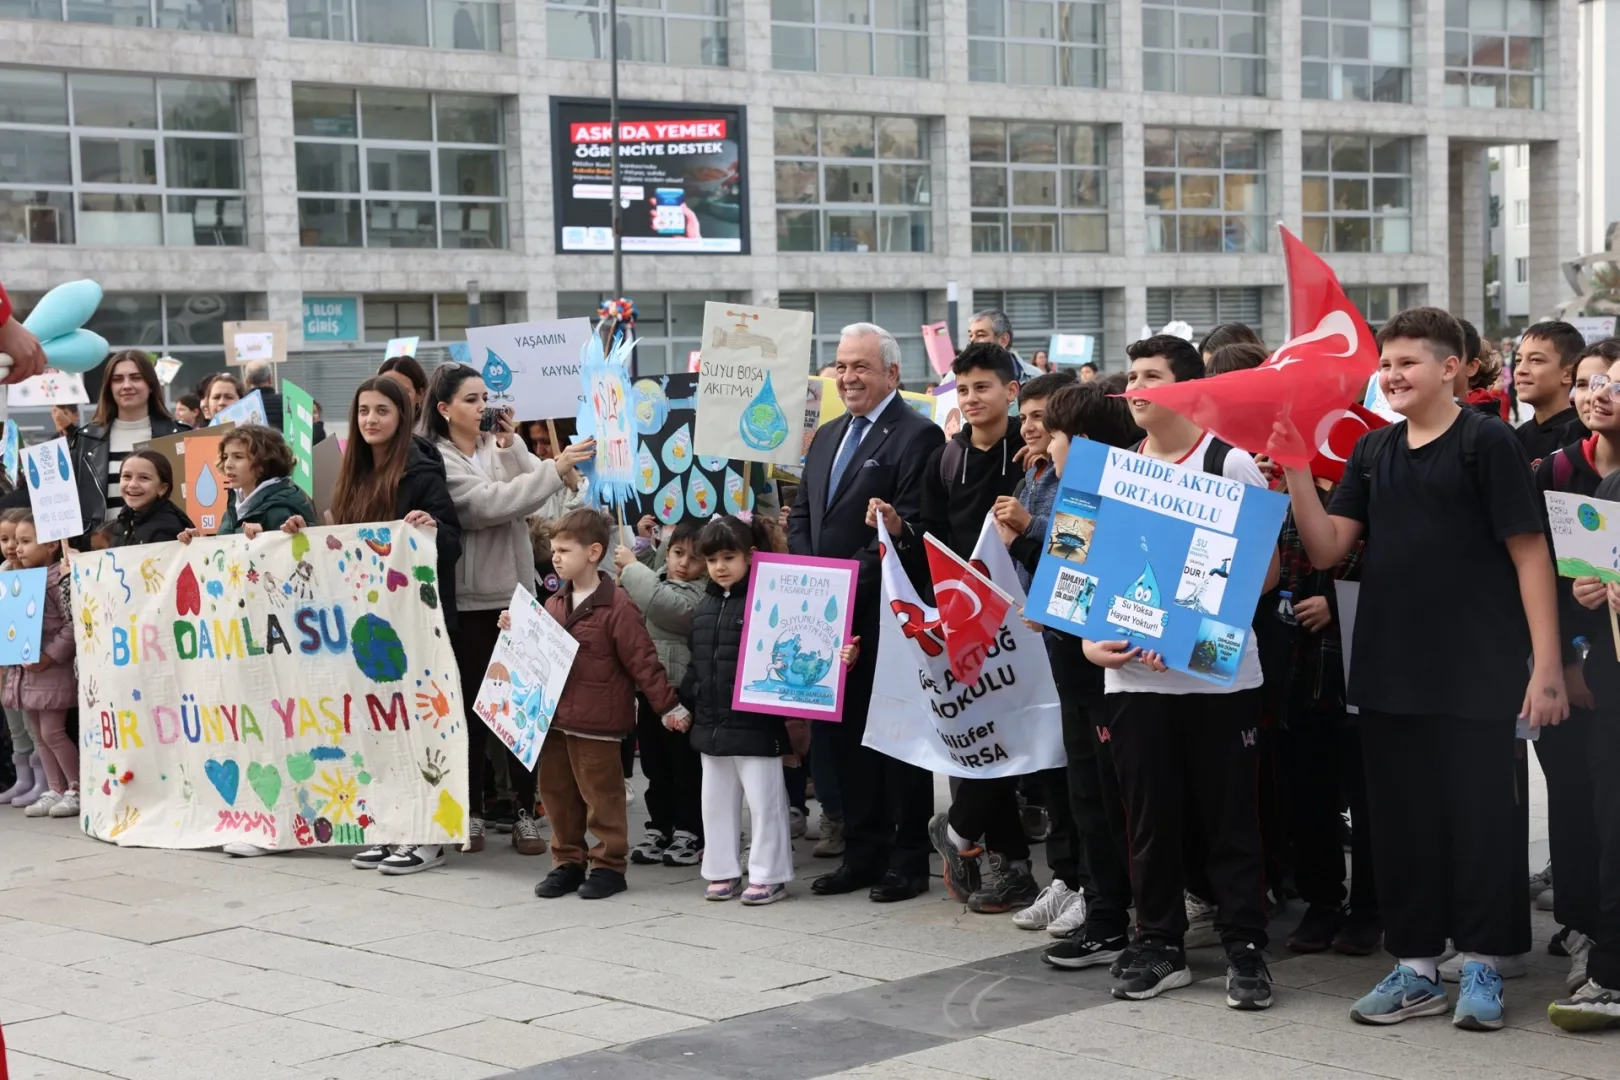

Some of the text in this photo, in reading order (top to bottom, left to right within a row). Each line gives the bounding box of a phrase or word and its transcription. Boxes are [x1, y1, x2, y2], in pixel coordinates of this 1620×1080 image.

[655, 123, 721, 138] YEMEK
[575, 142, 723, 158] ÖĞRNCİYE DESTEK
[312, 304, 343, 316] BLOK
[307, 317, 340, 336] GİRİŞ
[514, 333, 567, 349] YAŞAMIN
[541, 365, 582, 377] KAYNA
[701, 361, 764, 381] SUYU BOŞA
[703, 382, 753, 398] AKITMA!
[1110, 452, 1241, 502] VAHİDE AKTUĞ
[1113, 480, 1222, 524] ORTAOKULU
[202, 516, 214, 527] SU
[1195, 538, 1208, 548] SU
[1060, 571, 1085, 587] DAMLAYA
[1183, 565, 1201, 578] DUR
[780, 574, 830, 588] HER DAN
[1121, 599, 1153, 617] Su Yoksa
[1110, 609, 1159, 631] Hayat Yoktur!!
[112, 604, 348, 668] BİR DAMLA SU
[100, 702, 144, 750] BİR
[151, 693, 264, 745] DÜNYA
[950, 743, 1009, 769] URSA
